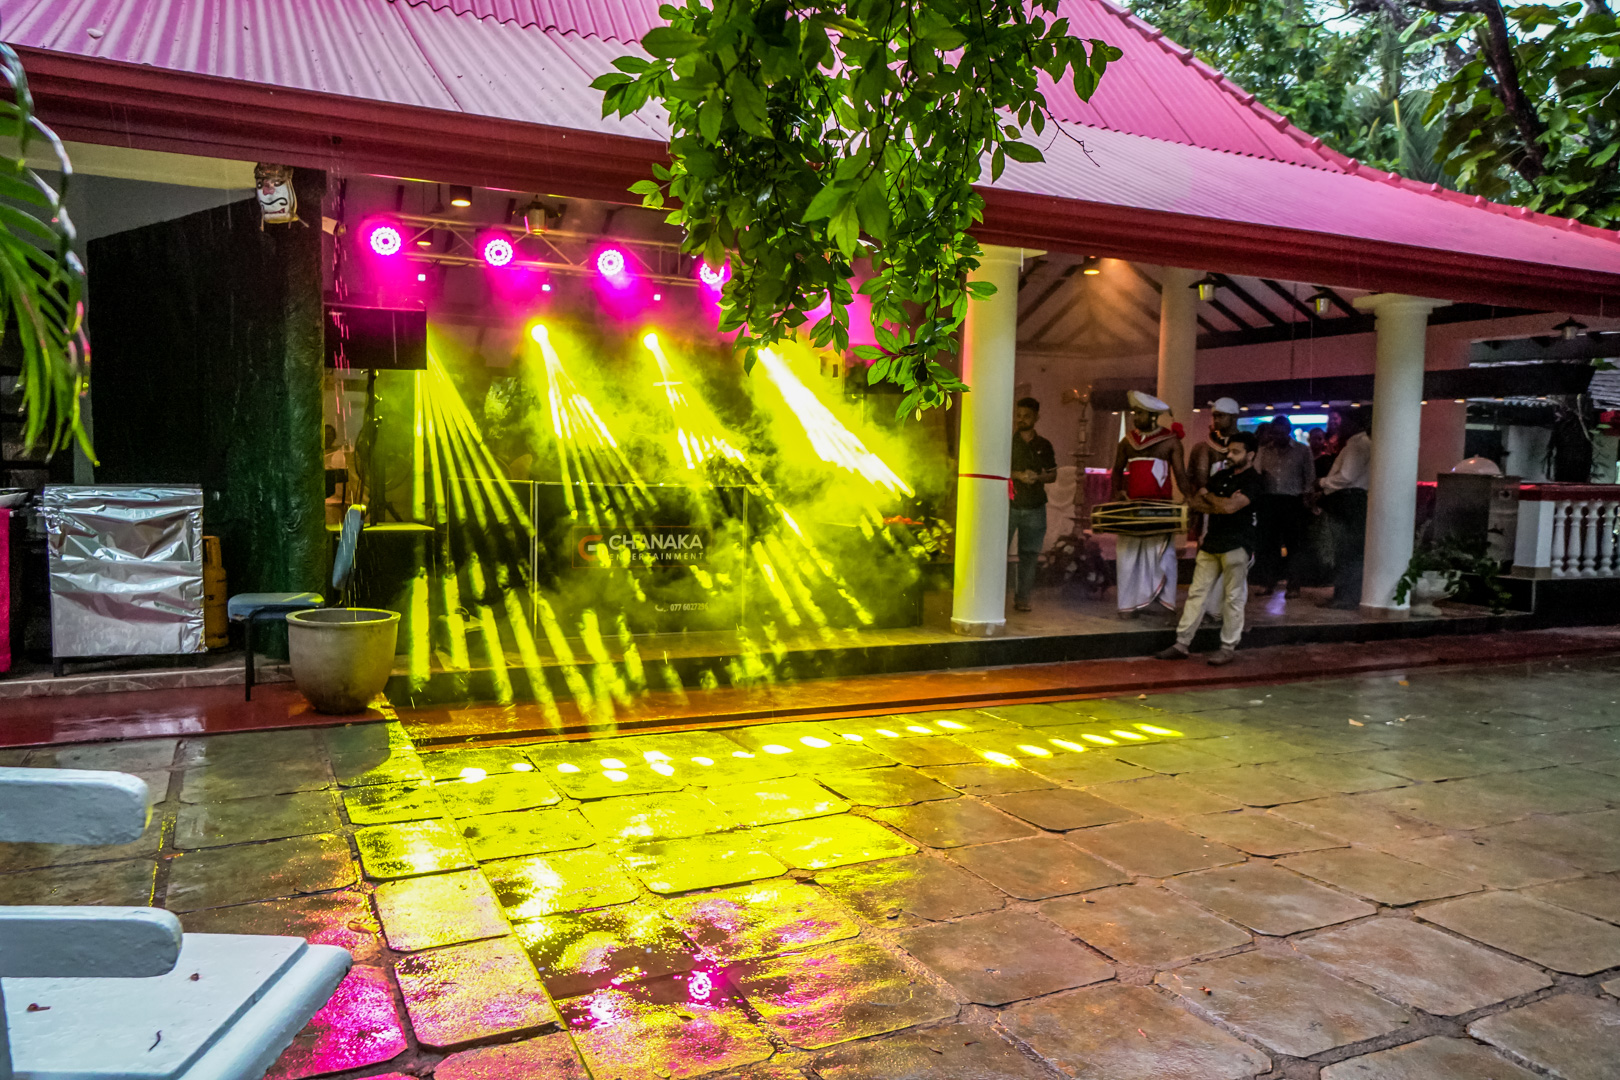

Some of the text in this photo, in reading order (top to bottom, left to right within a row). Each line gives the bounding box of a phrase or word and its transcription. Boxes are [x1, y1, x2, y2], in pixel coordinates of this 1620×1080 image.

[608, 534, 704, 550] CHANAKA
[608, 552, 704, 561] ENERTAINMENT
[669, 603, 682, 612] 077
